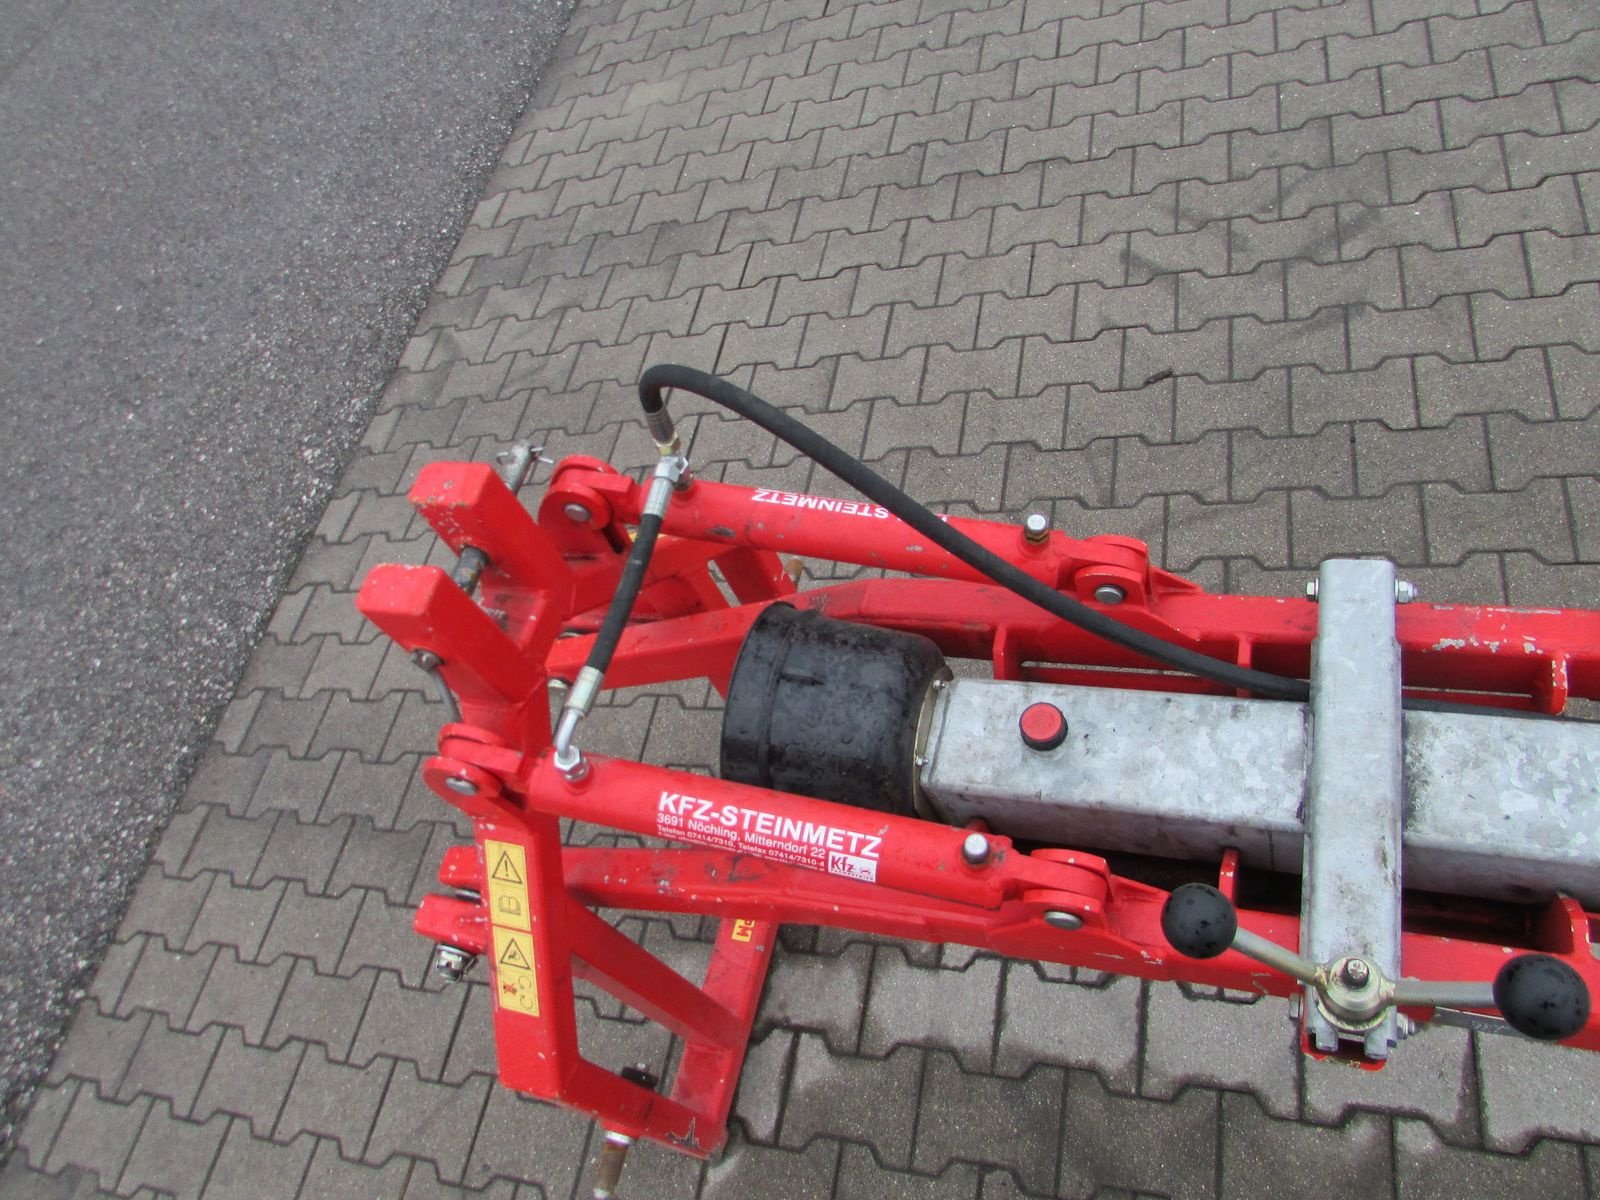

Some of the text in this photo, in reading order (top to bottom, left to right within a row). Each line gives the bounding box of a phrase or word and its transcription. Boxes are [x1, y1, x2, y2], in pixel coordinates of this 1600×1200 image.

[752, 490, 949, 522] STEINMETZ
[657, 813, 684, 827] 3691
[745, 832, 808, 855] Mitterndorf
[810, 847, 825, 859] 22
[657, 824, 685, 836] Telefon
[738, 842, 767, 855] Telefax
[658, 792, 882, 857] KFZ-STEINMETZ
[831, 855, 854, 872] Kfz
